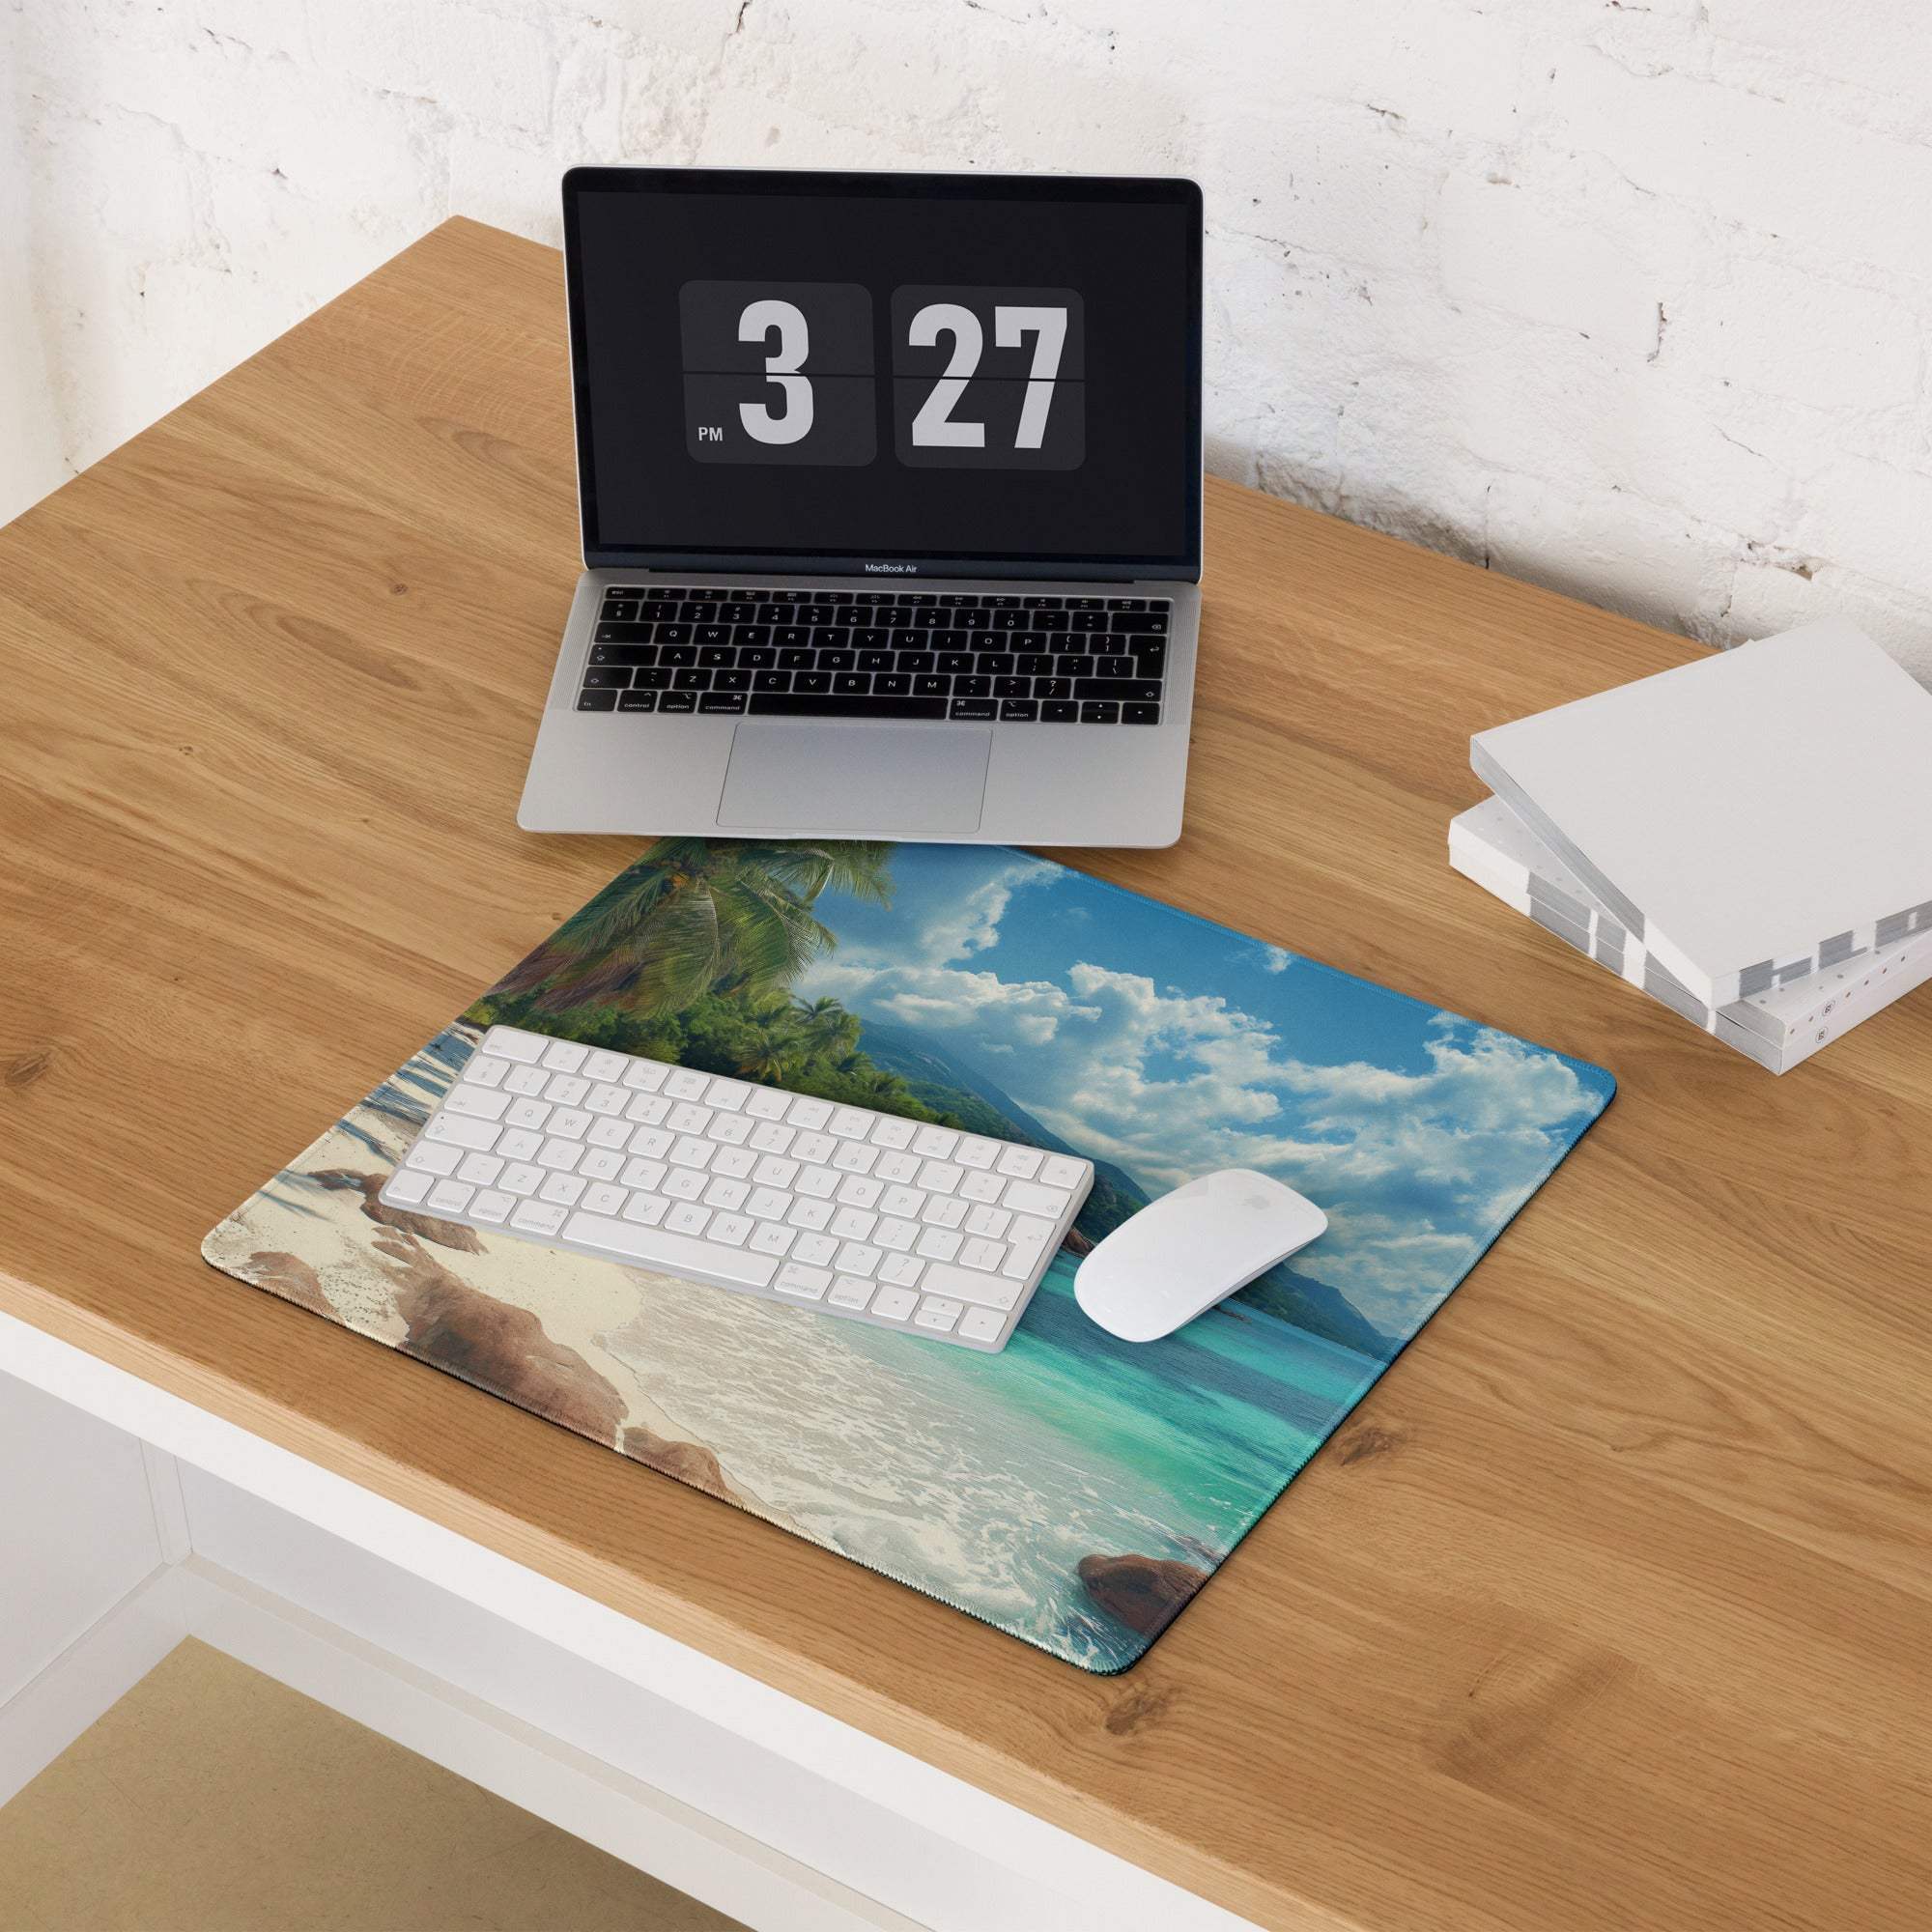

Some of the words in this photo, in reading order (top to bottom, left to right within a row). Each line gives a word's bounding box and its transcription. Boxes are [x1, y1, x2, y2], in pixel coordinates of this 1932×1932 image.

[738, 299, 814, 445] 3
[908, 302, 1068, 449] 27
[697, 427, 724, 441] PM
[865, 563, 904, 573] MacBook
[905, 564, 918, 573] Air
